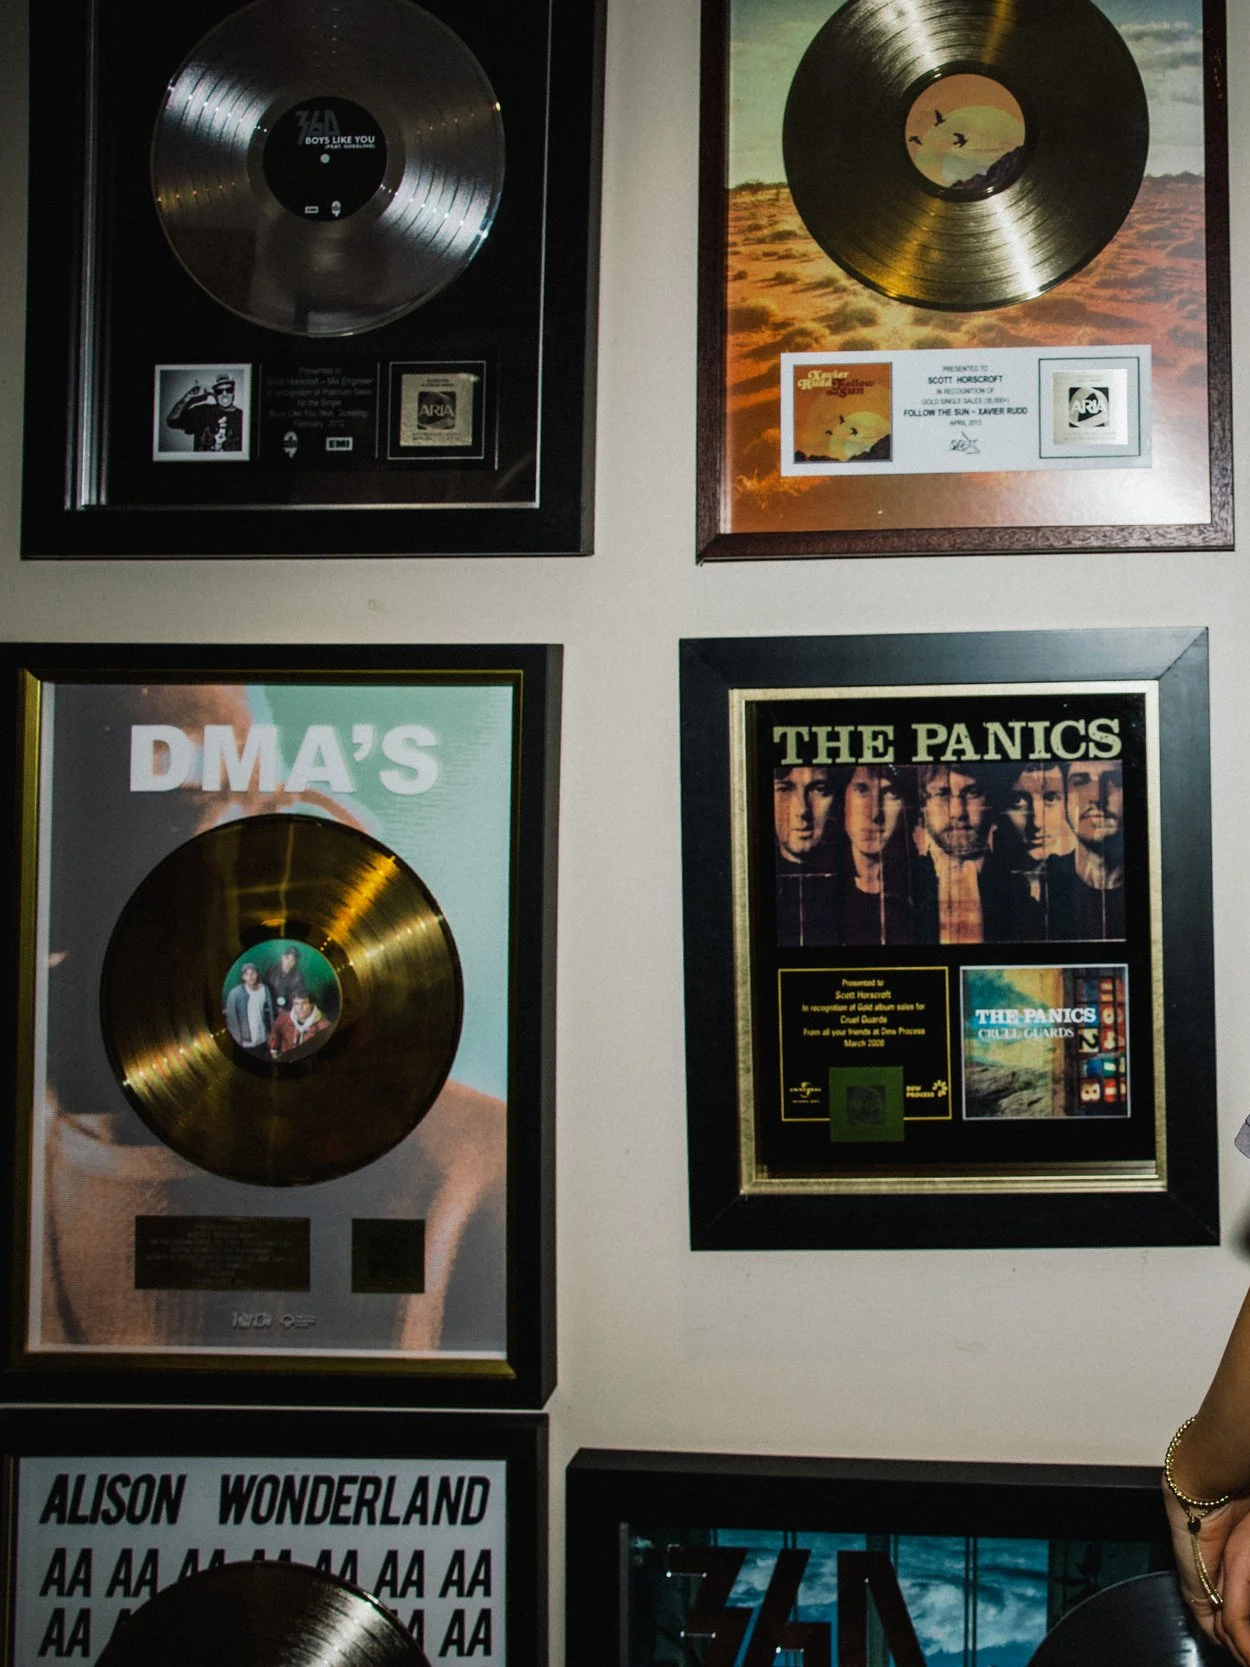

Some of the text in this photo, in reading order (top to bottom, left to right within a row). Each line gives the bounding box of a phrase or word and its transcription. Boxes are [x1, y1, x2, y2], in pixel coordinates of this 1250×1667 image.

[304, 135, 376, 145] BOYS LIKE YOU
[808, 370, 849, 380] Xavier
[928, 375, 1002, 385] SCOTT HORSCROFT
[797, 378, 874, 391] Rudd Follow
[838, 387, 865, 397] Sun
[419, 404, 455, 417] ARIA
[904, 408, 936, 417] FOLLOW
[938, 408, 952, 417] THE
[954, 407, 970, 416] SUN
[978, 406, 1004, 416] XAVIER
[1006, 406, 1029, 415] RUDD
[1071, 400, 1107, 414] ARIA
[327, 438, 352, 449] EMI
[773, 717, 1122, 765] THE PANICS
[130, 723, 440, 796] DMA'S
[842, 979, 886, 988] Presented to
[835, 990, 893, 1000] Scott Horscroft
[802, 1004, 809, 1012] In
[811, 1004, 849, 1013] recognition
[858, 1003, 874, 1012] Gold
[875, 1003, 896, 1011] album
[898, 1003, 915, 1011] sales
[916, 1002, 926, 1011] for
[840, 1015, 889, 1024] Cruel Guards
[975, 1007, 1097, 1025] THE PANICS
[803, 1027, 926, 1038] From all your friends at Dew Process
[977, 1026, 1075, 1041] CRUEL GUARDS
[843, 1038, 866, 1048] March
[40, 1474, 491, 1526] ALISON WONDERLAND
[39, 1548, 92, 1597] AA
[105, 1549, 159, 1597] AA
[374, 1549, 425, 1598] AA
[439, 1549, 491, 1598] AA
[38, 1607, 91, 1658] AA
[439, 1609, 491, 1658] AA
